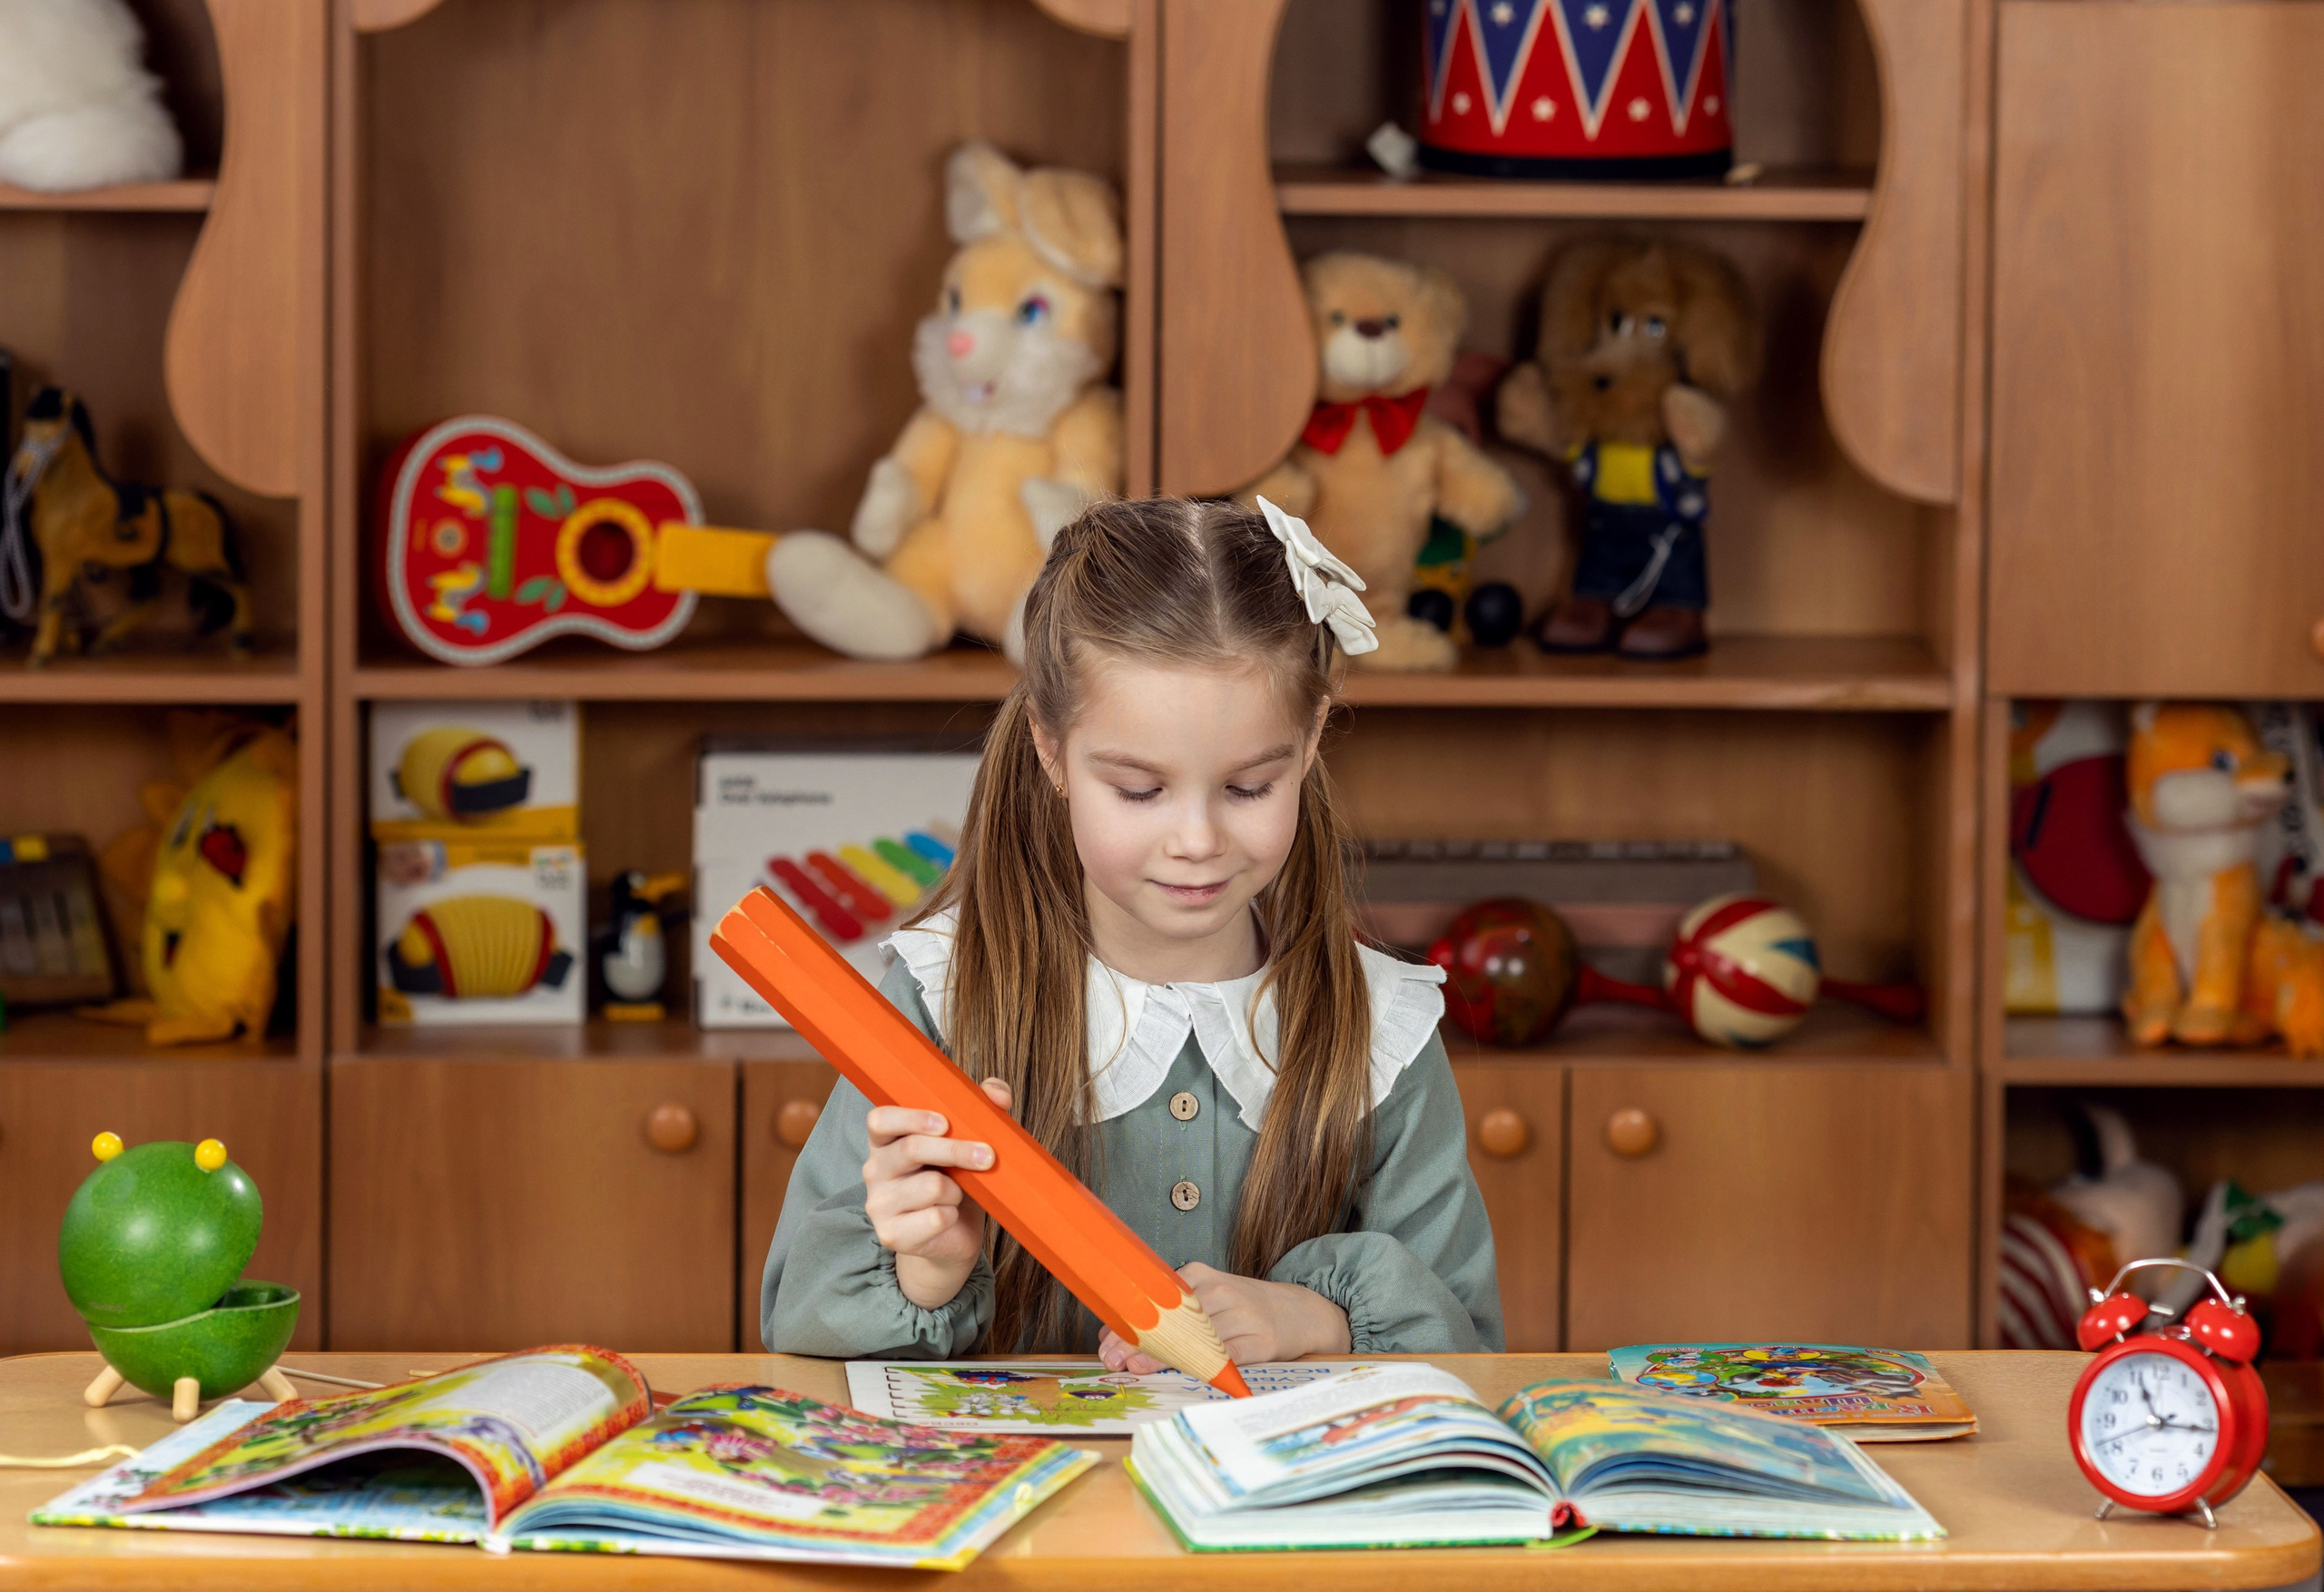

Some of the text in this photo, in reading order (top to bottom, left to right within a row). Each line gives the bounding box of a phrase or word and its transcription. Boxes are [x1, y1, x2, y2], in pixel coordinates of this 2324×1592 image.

[2154, 1363, 2171, 1381] 12
[2181, 1373, 2189, 1389] 1
[2112, 1390, 2129, 1406] 10
[2198, 1391, 2209, 1407] 2
[2104, 1413, 2117, 1430] 9
[2112, 1442, 2124, 1459] 8
[2195, 1443, 2206, 1460] 4
[2130, 1459, 2141, 1476] 7
[2178, 1464, 2190, 1479] 5
[2152, 1468, 2164, 1485] 6
